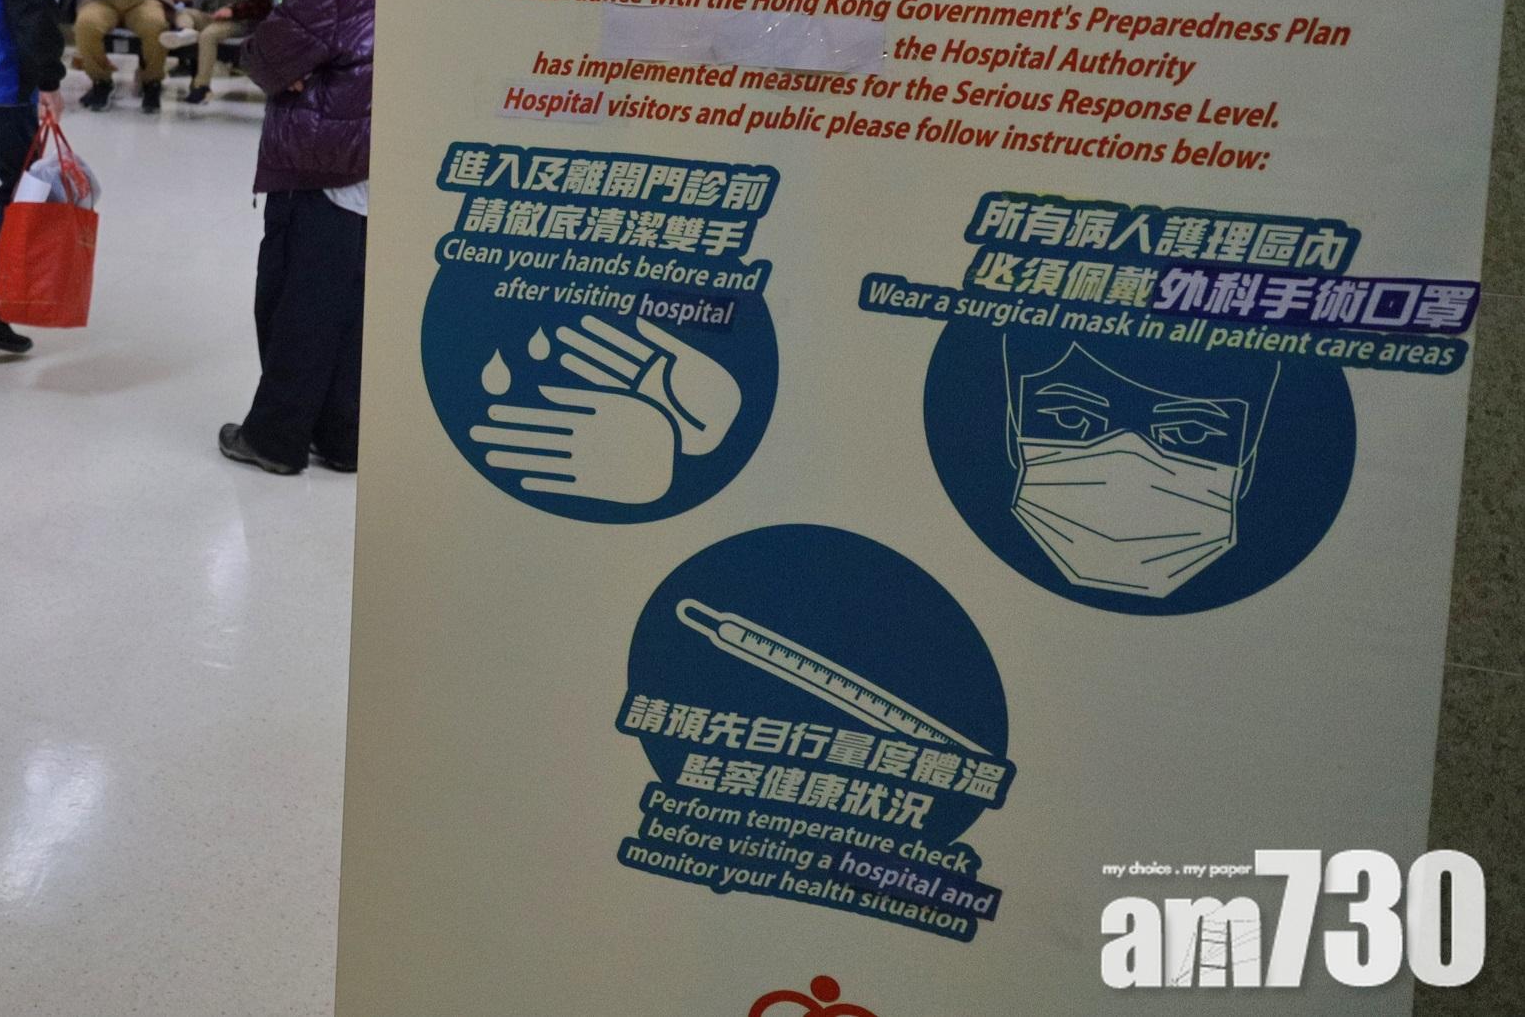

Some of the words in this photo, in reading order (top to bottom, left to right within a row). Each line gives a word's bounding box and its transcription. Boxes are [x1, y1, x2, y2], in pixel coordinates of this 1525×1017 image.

[894, 37, 936, 61] the
[942, 39, 1058, 71] Hospital
[1058, 47, 1196, 85] Authority
[1086, 7, 1280, 43] Preparedness
[1285, 17, 1351, 46] Plan
[532, 52, 572, 76] has
[578, 55, 736, 89] implemented
[741, 70, 856, 96] measures
[861, 74, 901, 100] for
[906, 78, 944, 102] the
[952, 81, 1052, 111] Serious
[1057, 89, 1193, 123] Response
[1197, 100, 1278, 129] Level.
[503, 88, 602, 117] Hospital
[608, 95, 691, 122] visitors
[696, 102, 744, 127] and
[745, 105, 825, 133] public
[826, 111, 910, 141] please
[915, 117, 999, 147] follow
[1002, 125, 1166, 163] instructions
[1171, 138, 1271, 171] below:
[446, 150, 771, 211] 進入及離開門診前
[443, 239, 502, 264] Clean
[505, 246, 555, 270] your
[561, 250, 630, 276] hands
[634, 257, 709, 285] before
[713, 268, 762, 290] and
[464, 197, 748, 256] 請徹底清潔雙手
[976, 200, 1349, 270] 所有病人護理區內
[495, 278, 548, 302] after
[554, 283, 635, 315] visiting
[640, 294, 734, 325] hospital
[869, 281, 932, 310] Wear
[934, 293, 950, 312] a
[955, 297, 1059, 328] surgical
[1061, 310, 1134, 336] mask
[1138, 315, 1164, 337] in
[1170, 319, 1207, 344] all
[1206, 324, 1312, 354] patient
[1315, 337, 1375, 359] care
[1379, 342, 1456, 366] areas
[625, 694, 1006, 801] 請預先自行量度體溫
[676, 753, 935, 830] 監察健康狀況
[648, 821, 723, 851] before
[728, 834, 816, 871] visiting
[817, 853, 834, 871] a
[838, 852, 942, 899] hospital
[941, 880, 995, 914] and
[649, 790, 742, 824] Perform
[746, 811, 895, 854] temperature
[899, 838, 971, 874] check
[626, 843, 718, 879] monitor
[719, 860, 777, 888] your
[779, 870, 855, 905] health
[859, 888, 969, 934] situation
